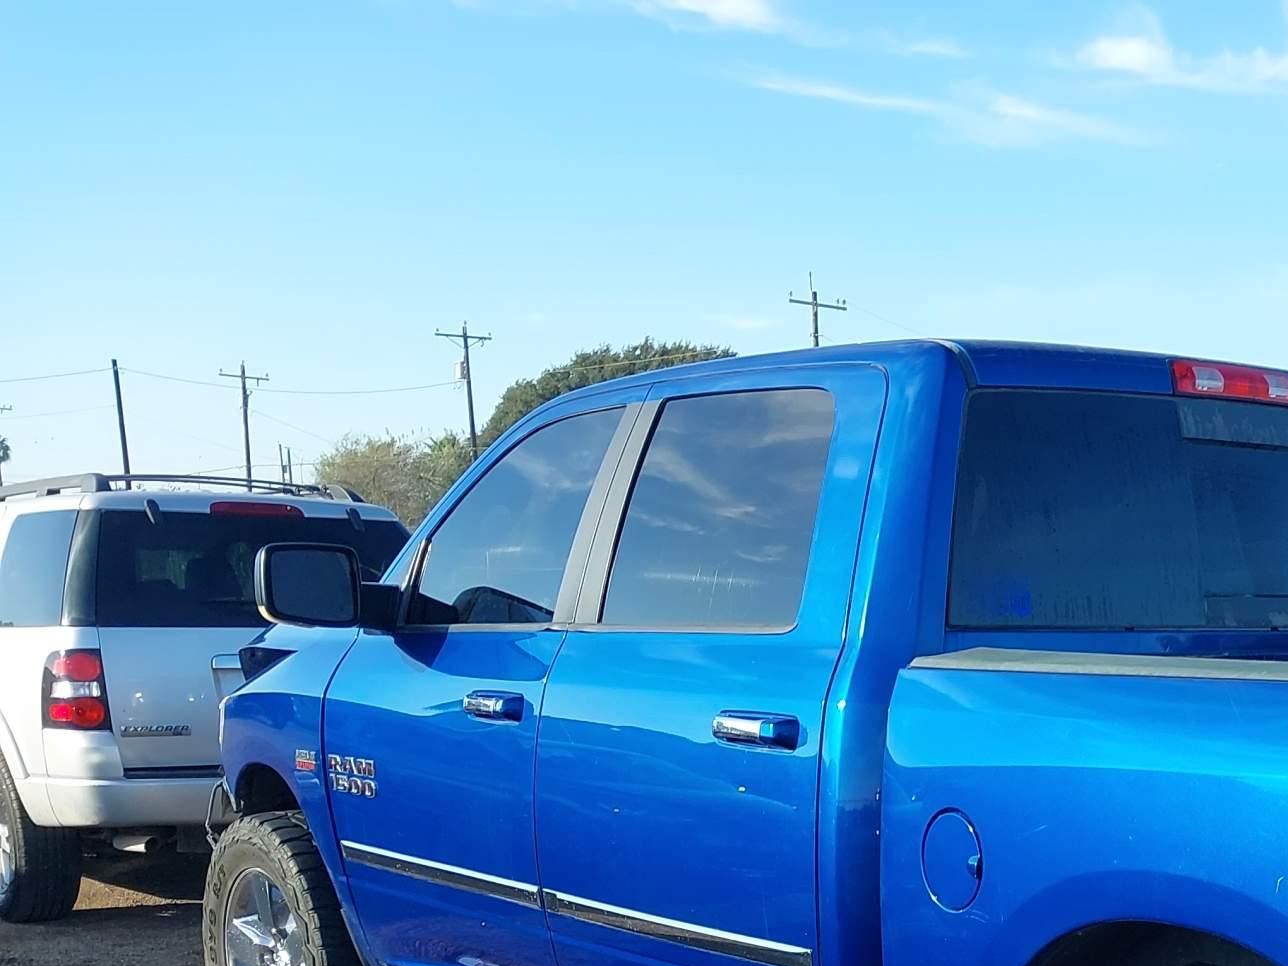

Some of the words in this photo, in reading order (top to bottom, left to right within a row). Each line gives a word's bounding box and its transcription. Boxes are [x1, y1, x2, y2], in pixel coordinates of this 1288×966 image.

[122, 724, 190, 733] EXPLORER
[327, 753, 375, 778] RAM
[328, 773, 377, 799] 1500
